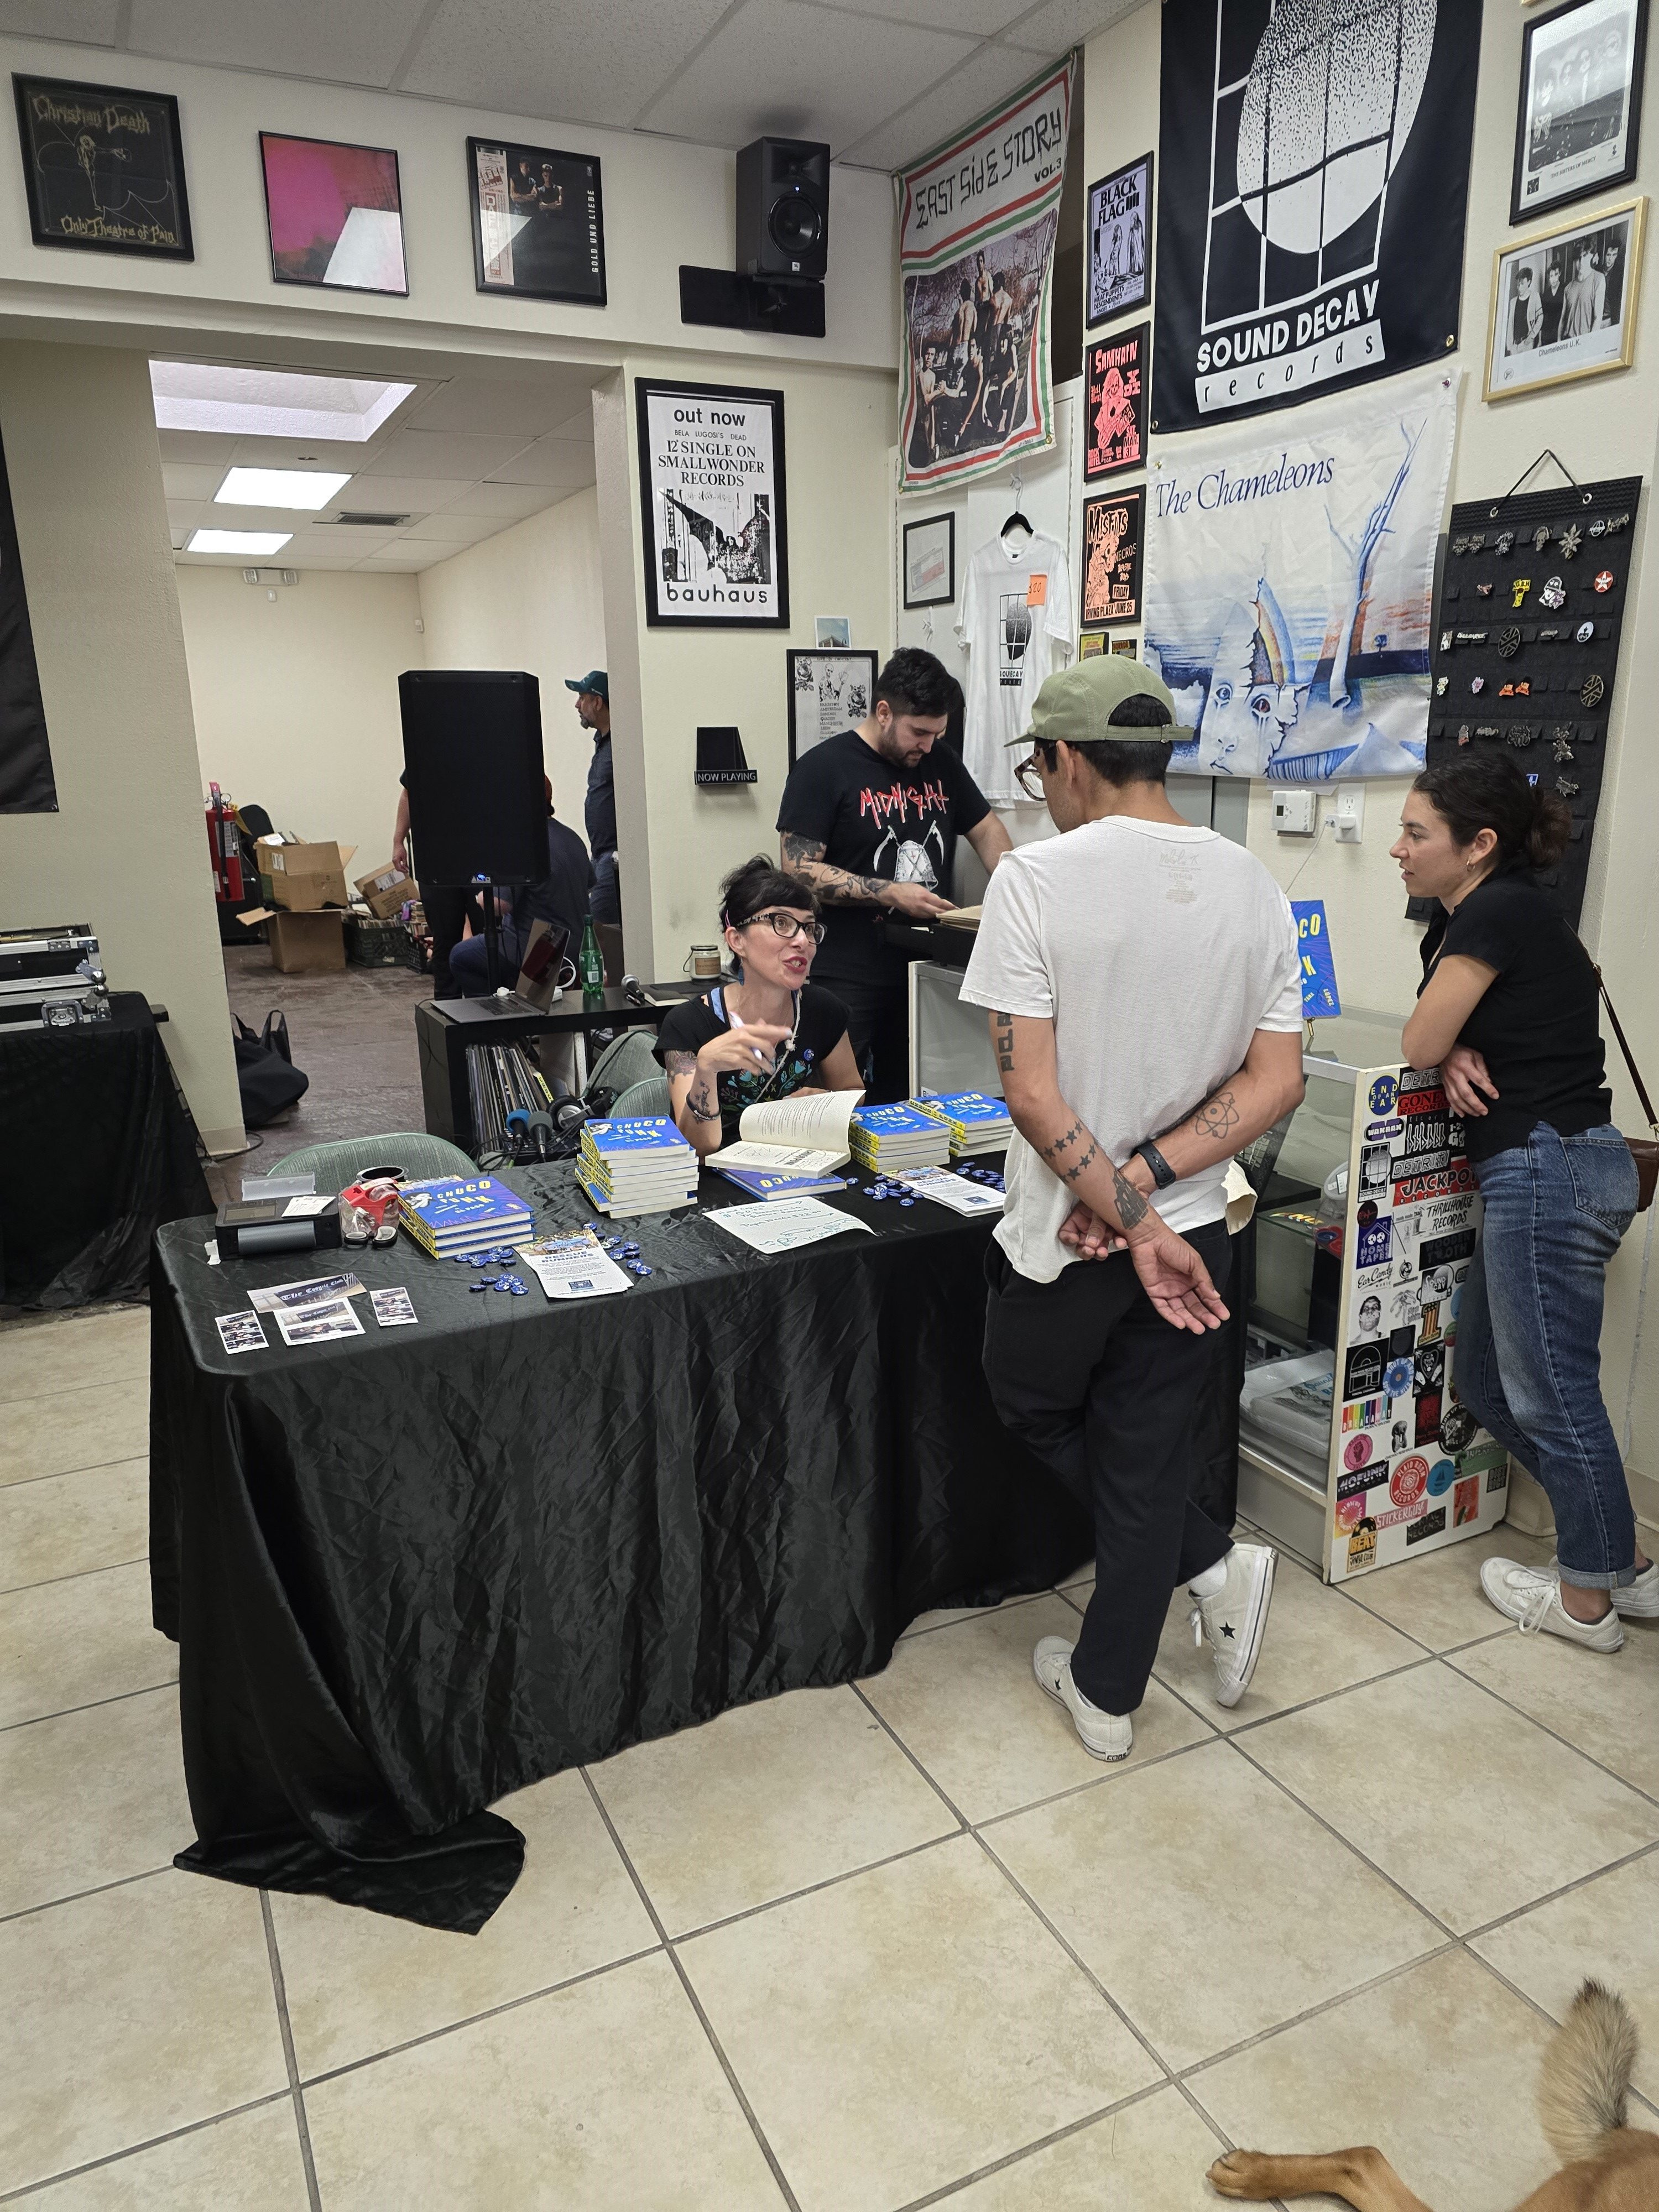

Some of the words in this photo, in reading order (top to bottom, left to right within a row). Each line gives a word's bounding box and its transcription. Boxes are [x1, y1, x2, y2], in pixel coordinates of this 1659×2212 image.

[915, 174, 956, 230] EAST
[1002, 107, 1062, 181] STORY
[1100, 173, 1137, 209] BLACK
[587, 190, 596, 220] LIEBE
[1098, 199, 1124, 227] FLAG
[589, 224, 597, 243] UND
[591, 248, 599, 273] GOLD
[1196, 320, 1290, 373] SOUND
[1296, 279, 1380, 347] DECAY
[1095, 340, 1138, 374] SAMHAIN
[1203, 334, 1374, 403] records
[674, 408, 703, 424] out
[711, 411, 746, 427] now
[695, 431, 724, 440] LUGOSI'S
[681, 441, 733, 457] SINGLE
[737, 445, 756, 458] ON
[681, 471, 744, 487] RECORDS
[1156, 478, 1191, 518] The
[1197, 452, 1335, 510] Chameleons
[1114, 542, 1136, 563] NECROS
[666, 582, 768, 603] bauhaus
[1114, 586, 1128, 597] FRIDAY
[1086, 606, 1099, 619] IRVING
[1100, 604, 1114, 617] PLAZA
[1126, 602, 1133, 613] 25
[697, 773, 719, 781] NOW
[721, 772, 756, 781] PLAYING
[1371, 1084, 1399, 1095] END
[1370, 1098, 1396, 1108] EAR
[1399, 1092, 1446, 1109] GONE
[617, 1119, 667, 1130] CHUCO
[437, 1180, 491, 1199] CHUCO
[440, 1195, 495, 1204] PUNK
[1423, 1195, 1474, 1218] THRILLHOUSE
[1433, 1210, 1468, 1231] RECORDS
[1360, 1243, 1390, 1256] HOME
[1360, 1251, 1390, 1264] TAPES
[1358, 1274, 1370, 1289] Ear
[1371, 1262, 1393, 1281] Candy
[1397, 1461, 1413, 1478] PLAID
[1394, 1489, 1419, 1503] RECORDS
[1349, 1534, 1376, 1552] BEAT
